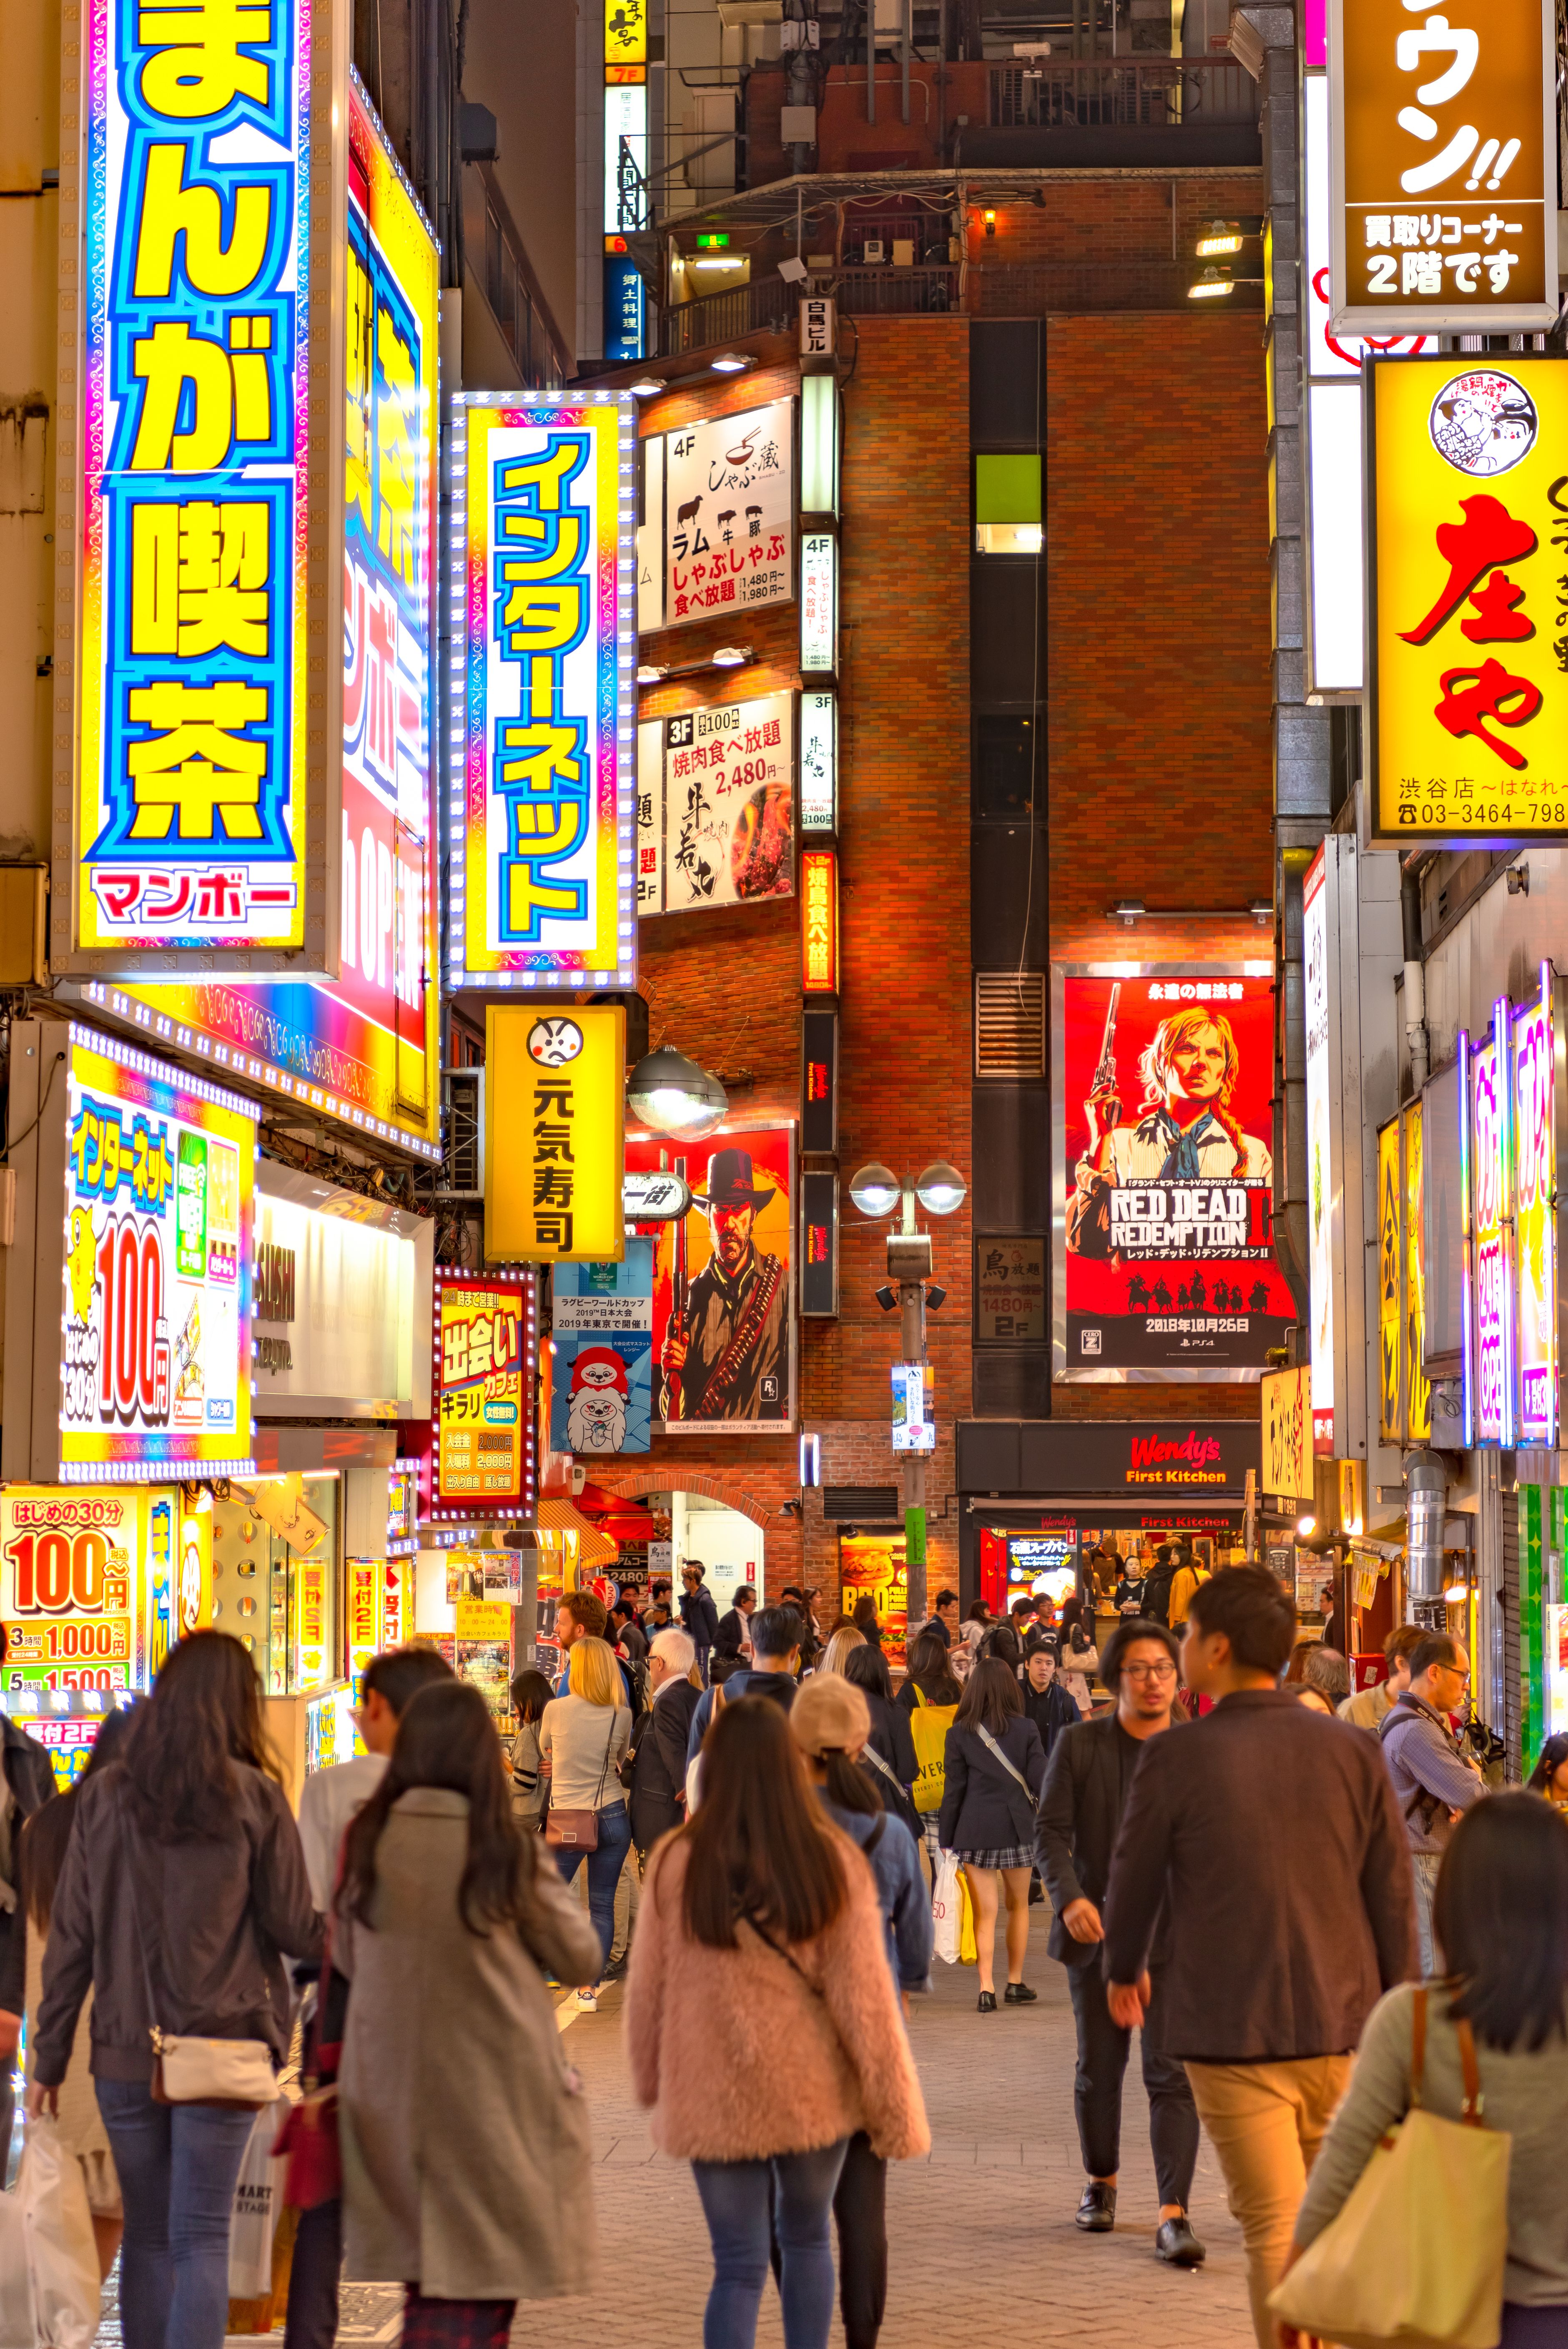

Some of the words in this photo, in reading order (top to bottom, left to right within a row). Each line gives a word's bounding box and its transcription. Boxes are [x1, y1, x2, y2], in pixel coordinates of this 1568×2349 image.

[614, 68, 637, 82] 7F
[1396, 0, 1521, 193] ウン!!
[1366, 213, 1523, 247] 買取りコーナー
[1367, 249, 1519, 295] 2階です
[622, 274, 637, 328] 郷土料理
[808, 301, 826, 352] 白馬ビル
[125, 0, 273, 838] まんが喫茶
[674, 435, 695, 458] 4F
[709, 440, 779, 492] しゃぶ蔵
[723, 529, 734, 545] 牛
[749, 519, 761, 538] 豚
[672, 528, 710, 562] ラム
[807, 539, 829, 552] 4F
[673, 534, 785, 591] しゃぶしゃぶ
[674, 578, 735, 617] 食べ放題
[1395, 494, 1543, 770] 庄や
[502, 443, 580, 932] インターネット
[815, 697, 831, 708] 3F
[670, 719, 691, 743] 3F
[672, 718, 781, 778] 焼肉食べ放題
[1399, 777, 1475, 799] 渋谷店
[1422, 803, 1568, 823] 03-3464-798
[640, 847, 656, 874] 題
[98, 873, 291, 919] マンボー
[808, 867, 828, 980] 焼鳥食べ放題
[1149, 982, 1244, 1000] 永遠の無法者
[72, 1109, 173, 1205] インターネット
[533, 1079, 575, 1252] 元気寿司
[625, 1185, 675, 1205] ー街
[1111, 1189, 1167, 1222] RED
[1172, 1188, 1247, 1222] DEAD
[814, 1226, 827, 1261] Wendy's
[1111, 1222, 1247, 1247] REDEMPTION
[982, 1249, 1040, 1280] 鳥放題
[562, 1299, 645, 1307] ラグビーワールドカップ
[98, 1227, 161, 1408] 100
[559, 1319, 647, 1329] 2019年東京で開催！
[995, 1316, 1029, 1336] 2F
[1146, 1318, 1249, 1333] 2018年10月26日
[444, 1309, 517, 1383] 出会い
[1086, 1337, 1098, 1348] Z
[484, 1371, 518, 1400] カフェ
[442, 1392, 481, 1420] キラリ
[486, 1405, 514, 1420] 女性無料!
[446, 1433, 471, 1449] 入会金
[478, 1434, 513, 1452] 2,000円
[1131, 1430, 1221, 1468] Wendy's
[446, 1453, 470, 1470] 入場料
[477, 1453, 512, 1469] 2,000円
[446, 1474, 479, 1490] 出入り自由
[484, 1474, 511, 1489] 話し放題
[1126, 1471, 1163, 1483] First
[1166, 1470, 1226, 1483] Kitchen
[14, 1501, 121, 1526] はじめの30分
[1041, 1515, 1076, 1528] Wendy's
[1141, 1517, 1173, 1527] First
[1176, 1516, 1229, 1527] Kitchen
[110, 1549, 127, 1560] 税込
[8, 1533, 104, 1609] 100
[153, 1513, 169, 1676] まん
[356, 1571, 371, 1641] 受付2F
[10, 1628, 41, 1646] 3時間
[47, 1626, 112, 1659] 1,000
[46, 1669, 111, 1690] 1500
[26, 1724, 97, 1743] 受付2F
